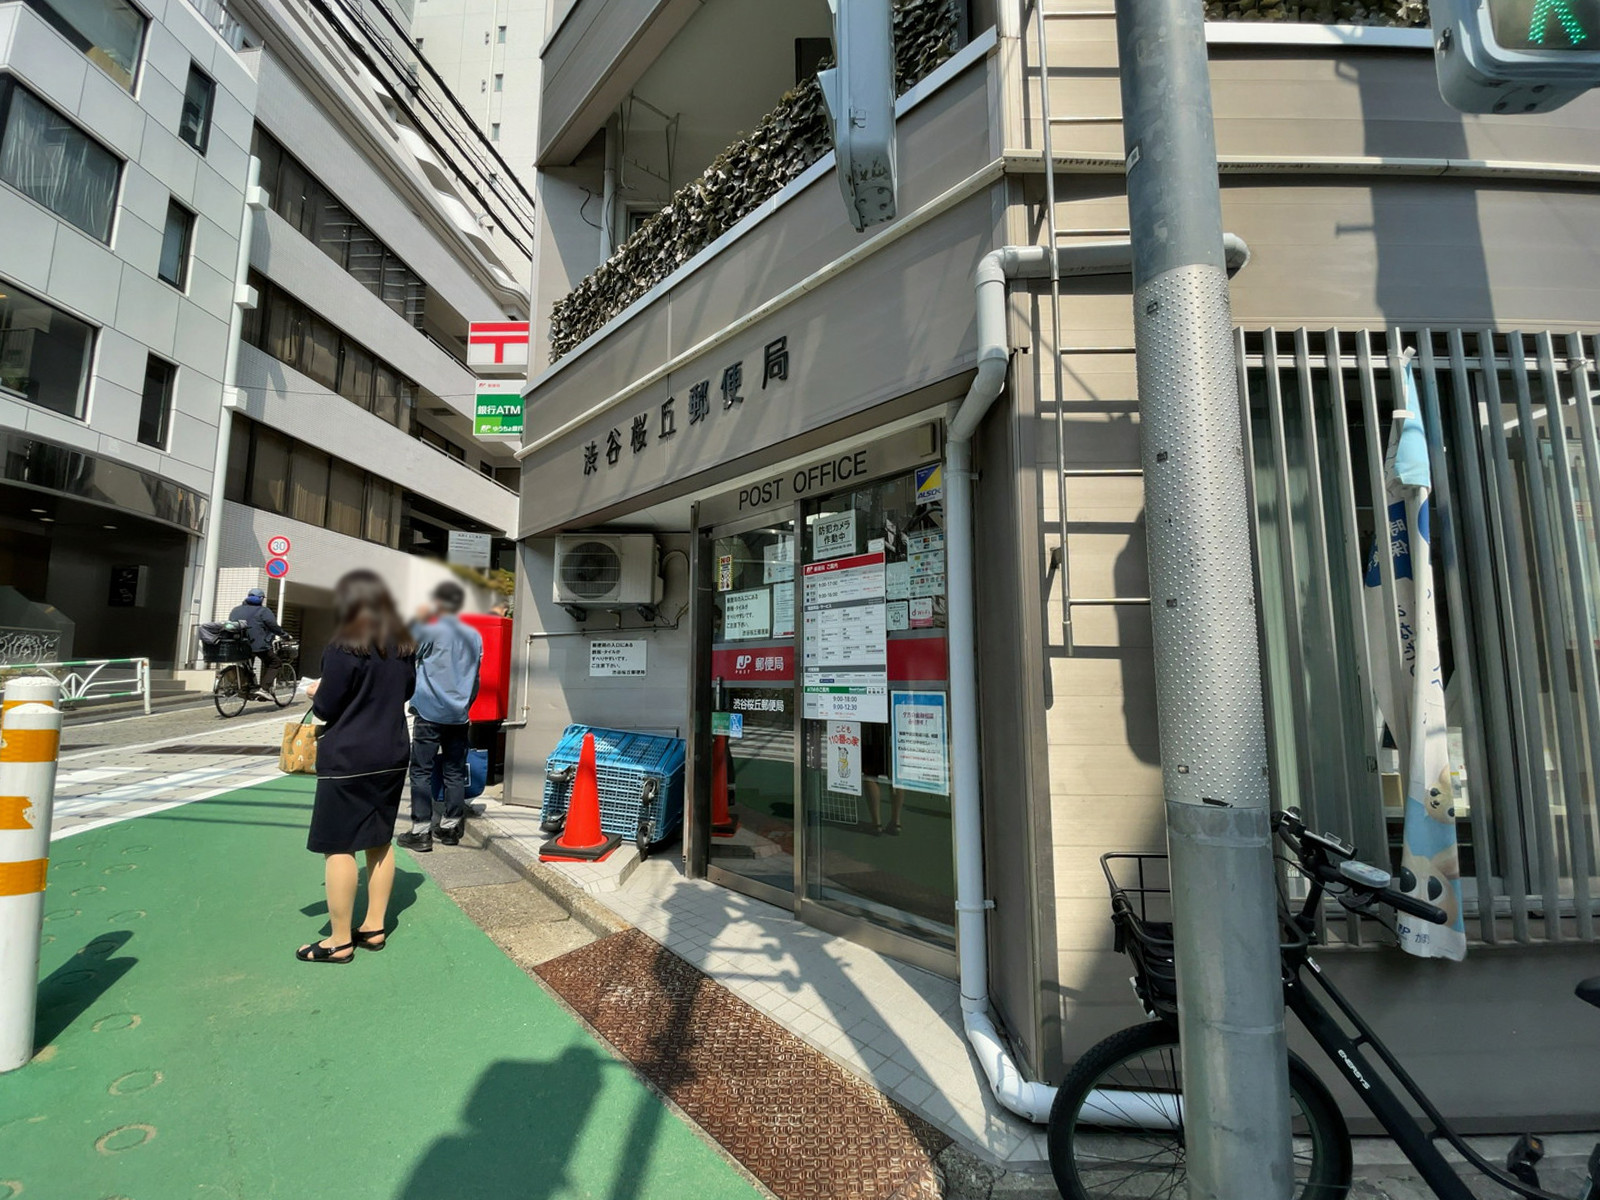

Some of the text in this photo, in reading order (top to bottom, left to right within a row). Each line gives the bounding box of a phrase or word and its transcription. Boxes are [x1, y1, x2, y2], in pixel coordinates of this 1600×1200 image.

[477, 405, 521, 415] 銀行ATM
[583, 336, 789, 476] 渋谷桜丘郵便局
[739, 451, 868, 511] POST OFFICE
[818, 520, 851, 535] 防犯カメラ
[273, 541, 286, 551] 30
[823, 533, 846, 545] 作動中
[755, 656, 784, 671] 郵便局
[733, 698, 785, 712] 渋谷桜丘郵便局
[835, 725, 852, 734] こども
